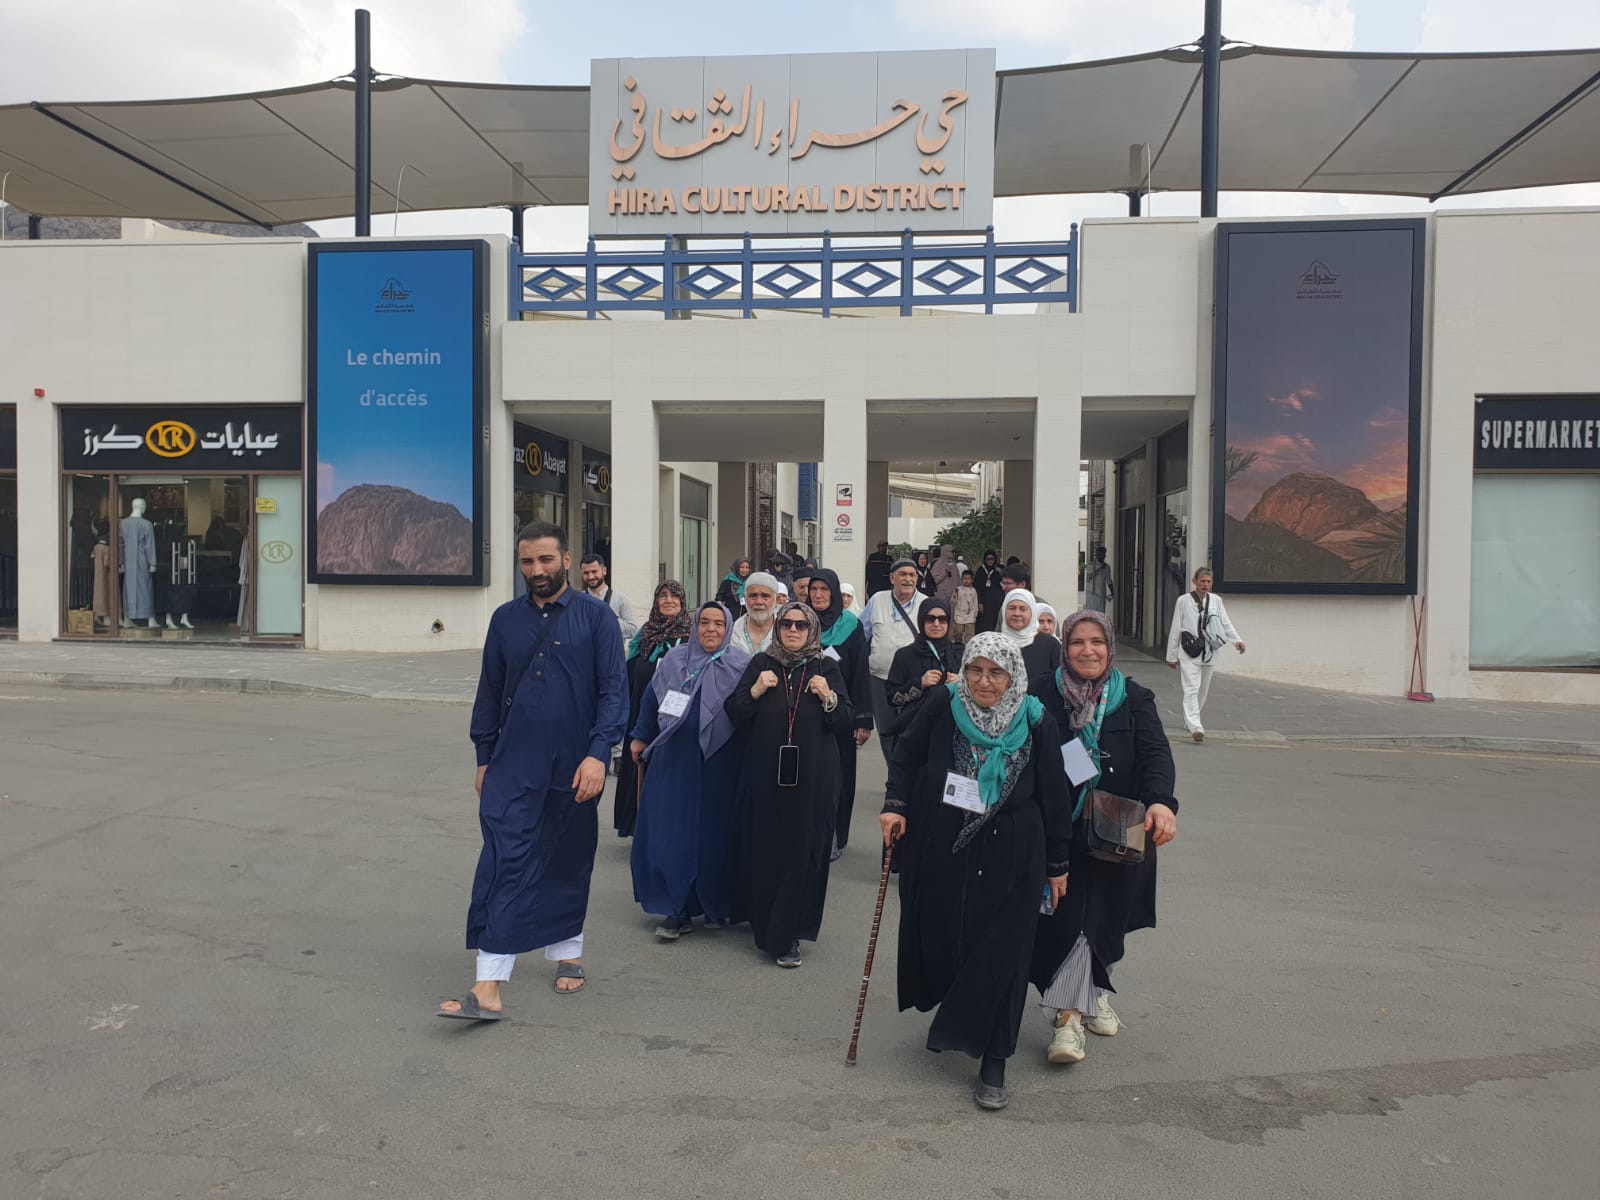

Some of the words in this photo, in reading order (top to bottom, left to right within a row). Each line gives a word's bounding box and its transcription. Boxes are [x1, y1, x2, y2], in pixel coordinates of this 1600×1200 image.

[609, 75, 765, 181] الثقافي
[768, 95, 920, 159] حراء
[916, 89, 969, 174] حي
[608, 186, 678, 215] HIRA
[681, 184, 829, 214] CULTURAL
[834, 181, 967, 213] DISTRICT
[347, 349, 368, 366] Le
[372, 348, 441, 366] chemin
[360, 389, 428, 407] d'accès
[82, 424, 143, 456] كرز
[200, 421, 279, 456] عبايات
[1481, 419, 1600, 449] SUPERMARKET
[543, 450, 567, 476] Abayat
